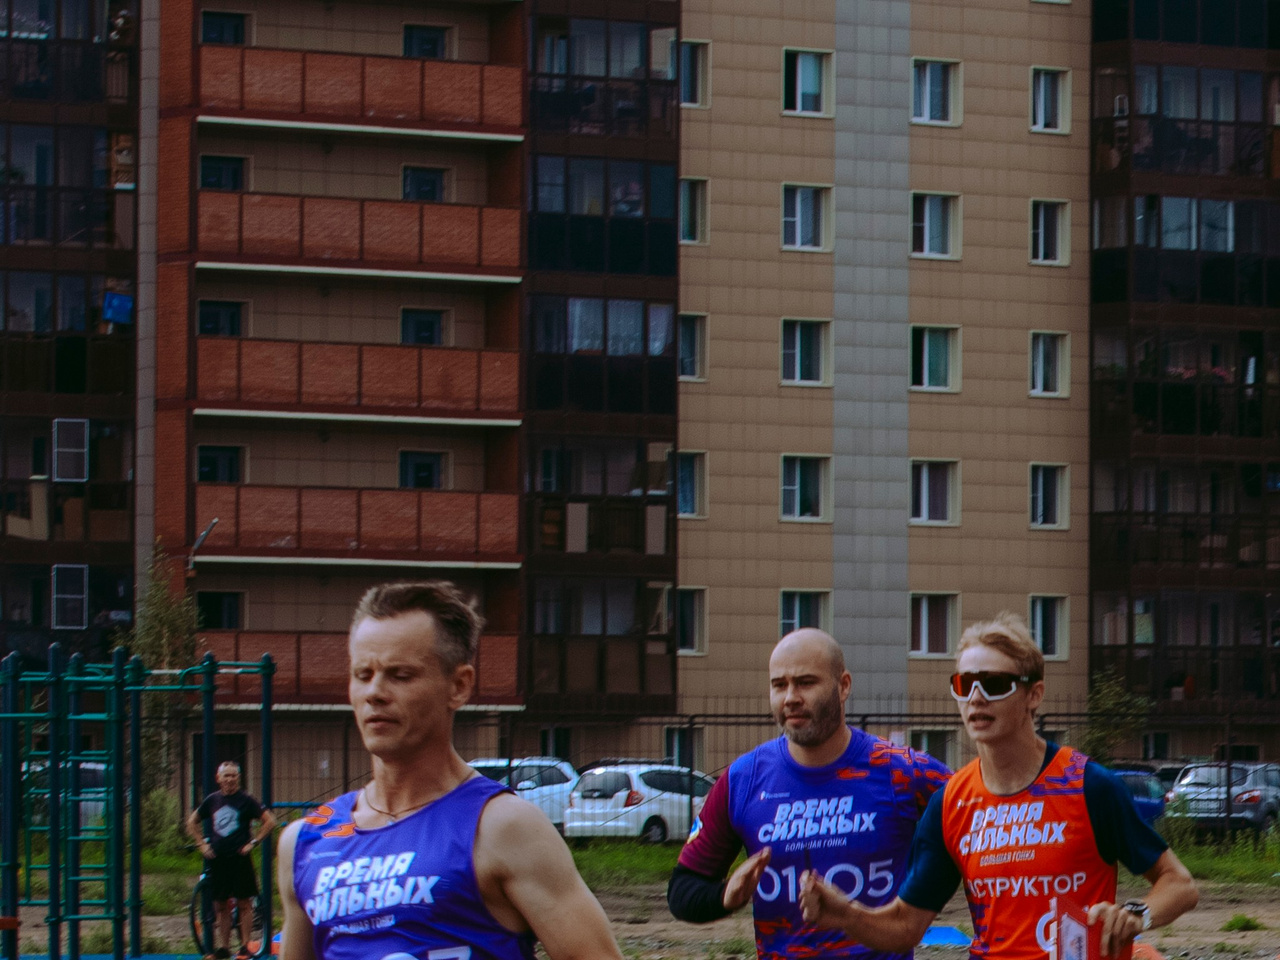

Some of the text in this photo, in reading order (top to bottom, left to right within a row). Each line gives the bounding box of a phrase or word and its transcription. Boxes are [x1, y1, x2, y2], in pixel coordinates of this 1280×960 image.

[774, 795, 853, 824] ВРЕМЯ
[971, 801, 1044, 832] ВРЕМЯ
[758, 812, 877, 843] СИЛЬНЫХ
[823, 837, 847, 849] ГОНКА
[959, 821, 1067, 856] СИЛЬНЫХ
[314, 851, 417, 895] ВРЕМЯ
[304, 875, 440, 925] СИЛЬНЫХ
